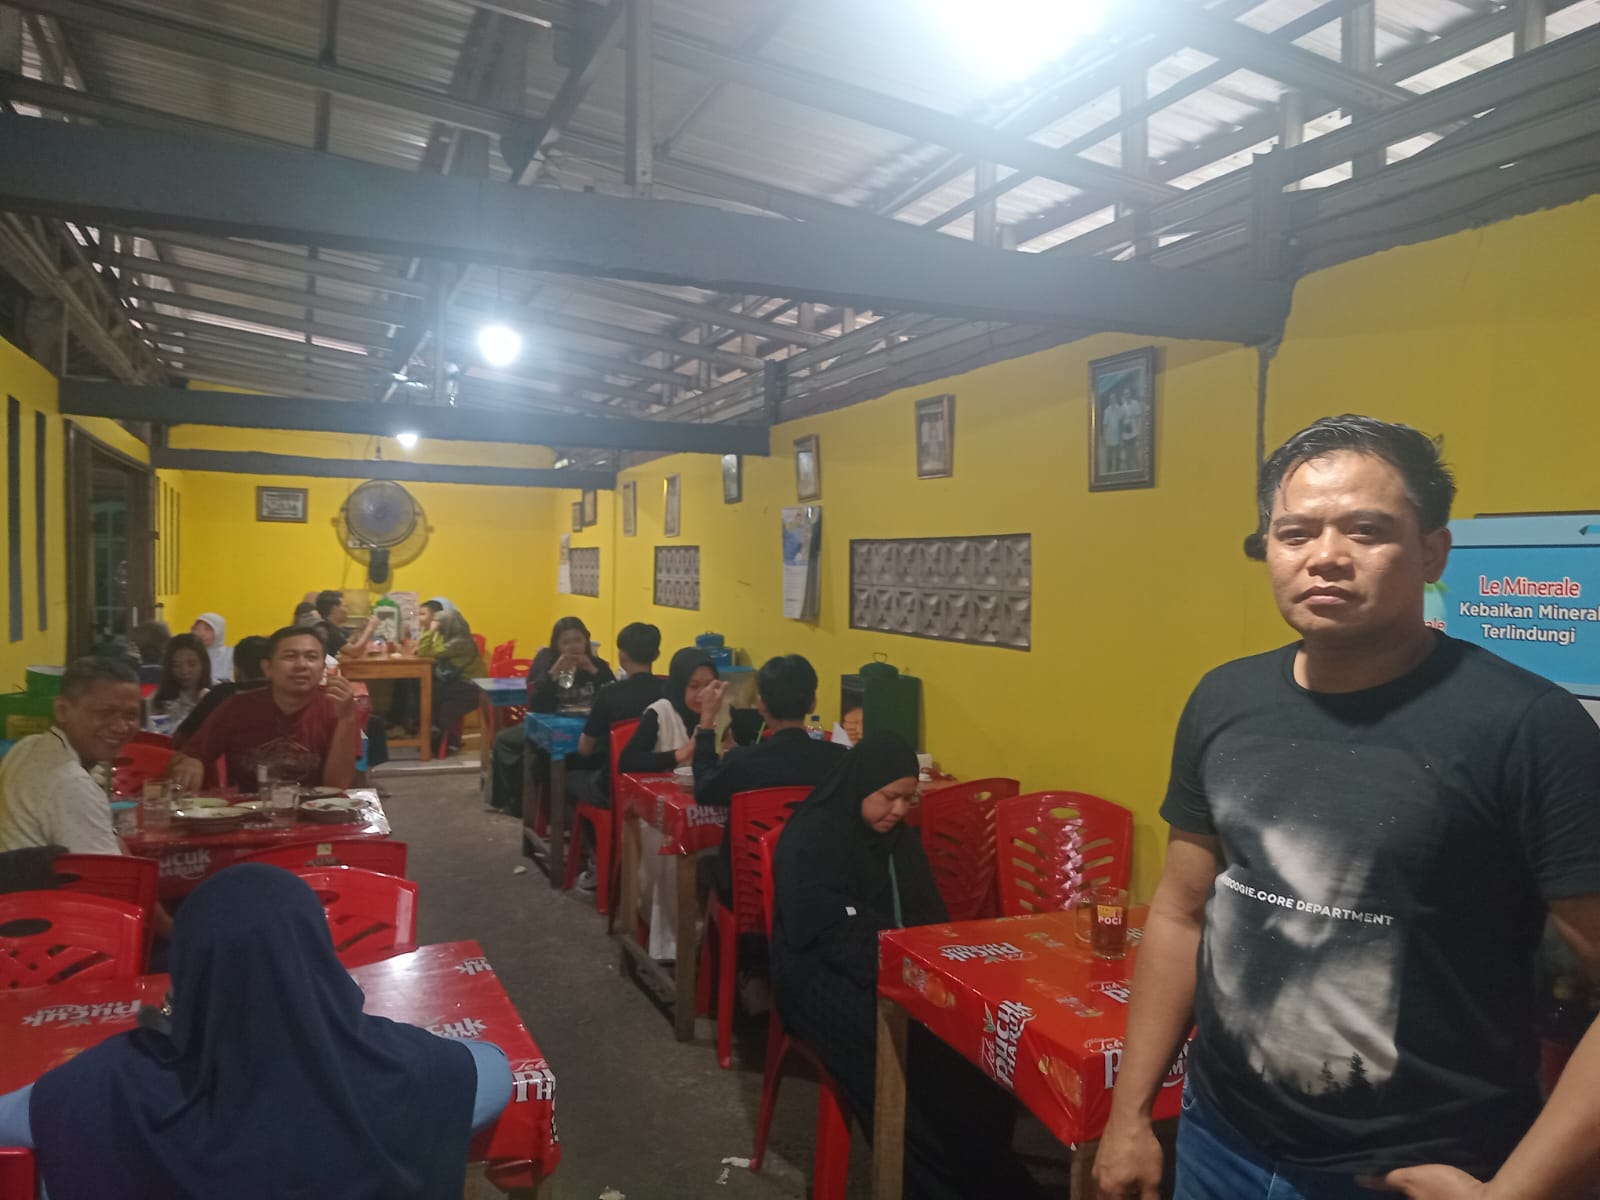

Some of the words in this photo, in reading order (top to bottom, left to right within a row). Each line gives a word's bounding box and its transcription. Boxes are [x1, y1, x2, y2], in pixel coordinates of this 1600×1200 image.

[1480, 576, 1500, 595] Le
[1503, 576, 1581, 597] Minerale
[1459, 602, 1533, 618] Kebaikan
[1481, 623, 1576, 645] Terlindungi
[1097, 914, 1122, 926] POCI
[1296, 900, 1394, 926] DEPARTMENT
